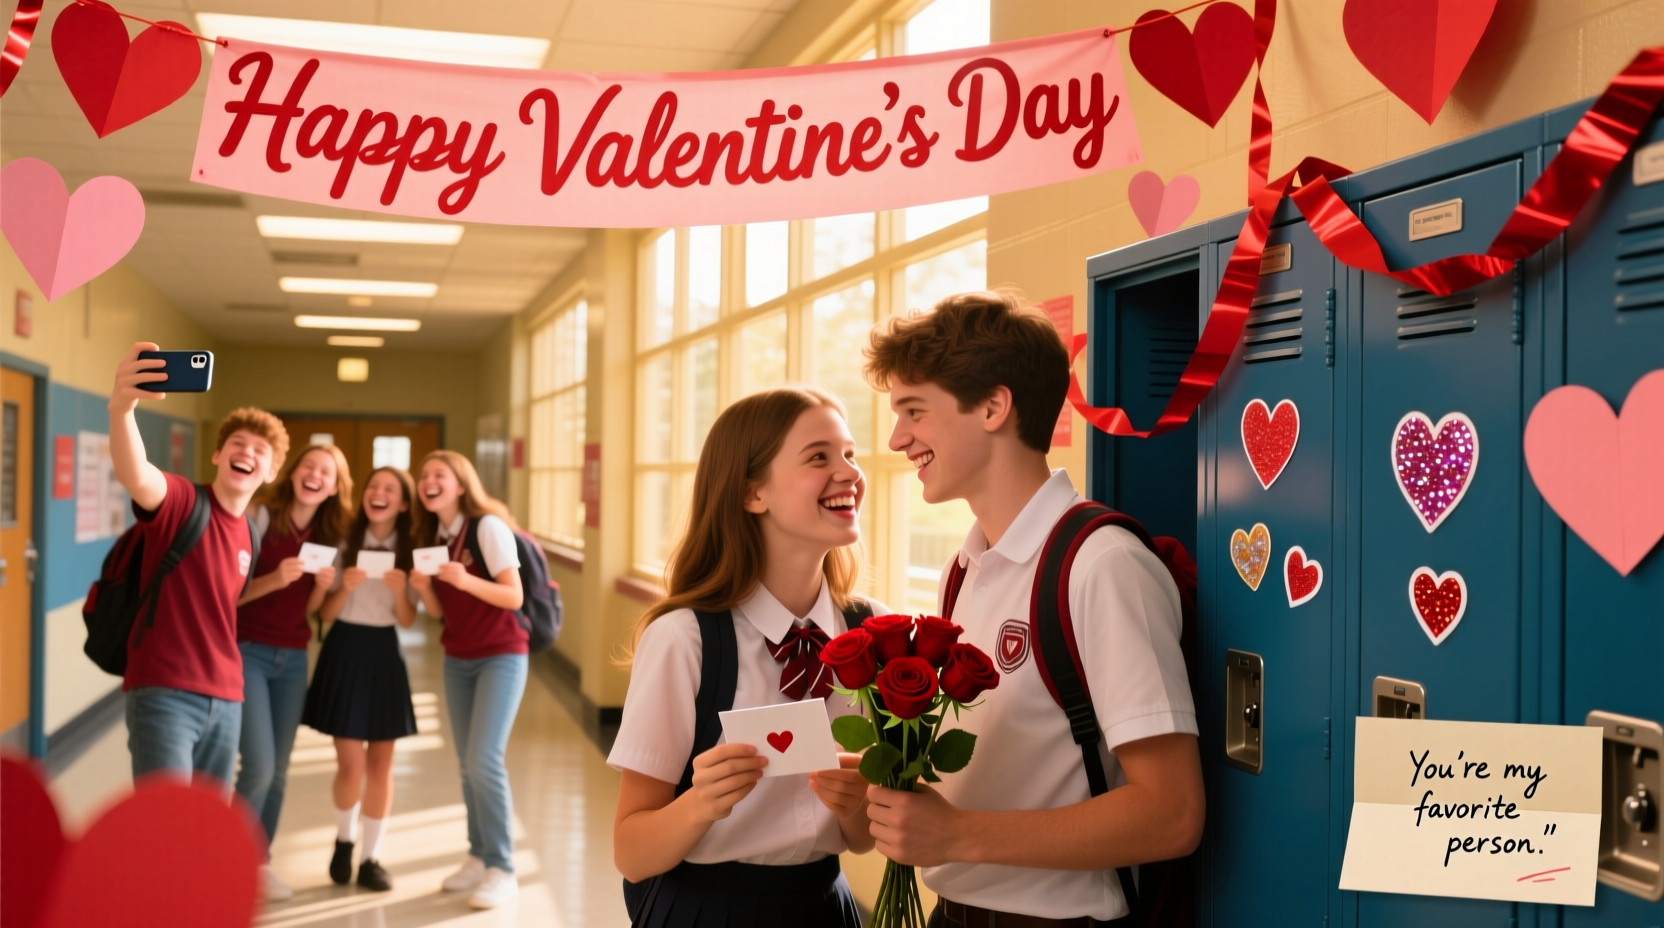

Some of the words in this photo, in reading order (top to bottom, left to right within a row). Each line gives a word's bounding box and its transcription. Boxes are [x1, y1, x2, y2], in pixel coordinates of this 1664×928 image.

[218, 51, 506, 215] Happy
[519, 82, 940, 196] Valentine's
[947, 57, 1120, 170] Day
[1410, 749, 1491, 787] You're
[1503, 763, 1548, 799] my
[1413, 790, 1520, 827] favorite
[1444, 823, 1557, 868] person."
